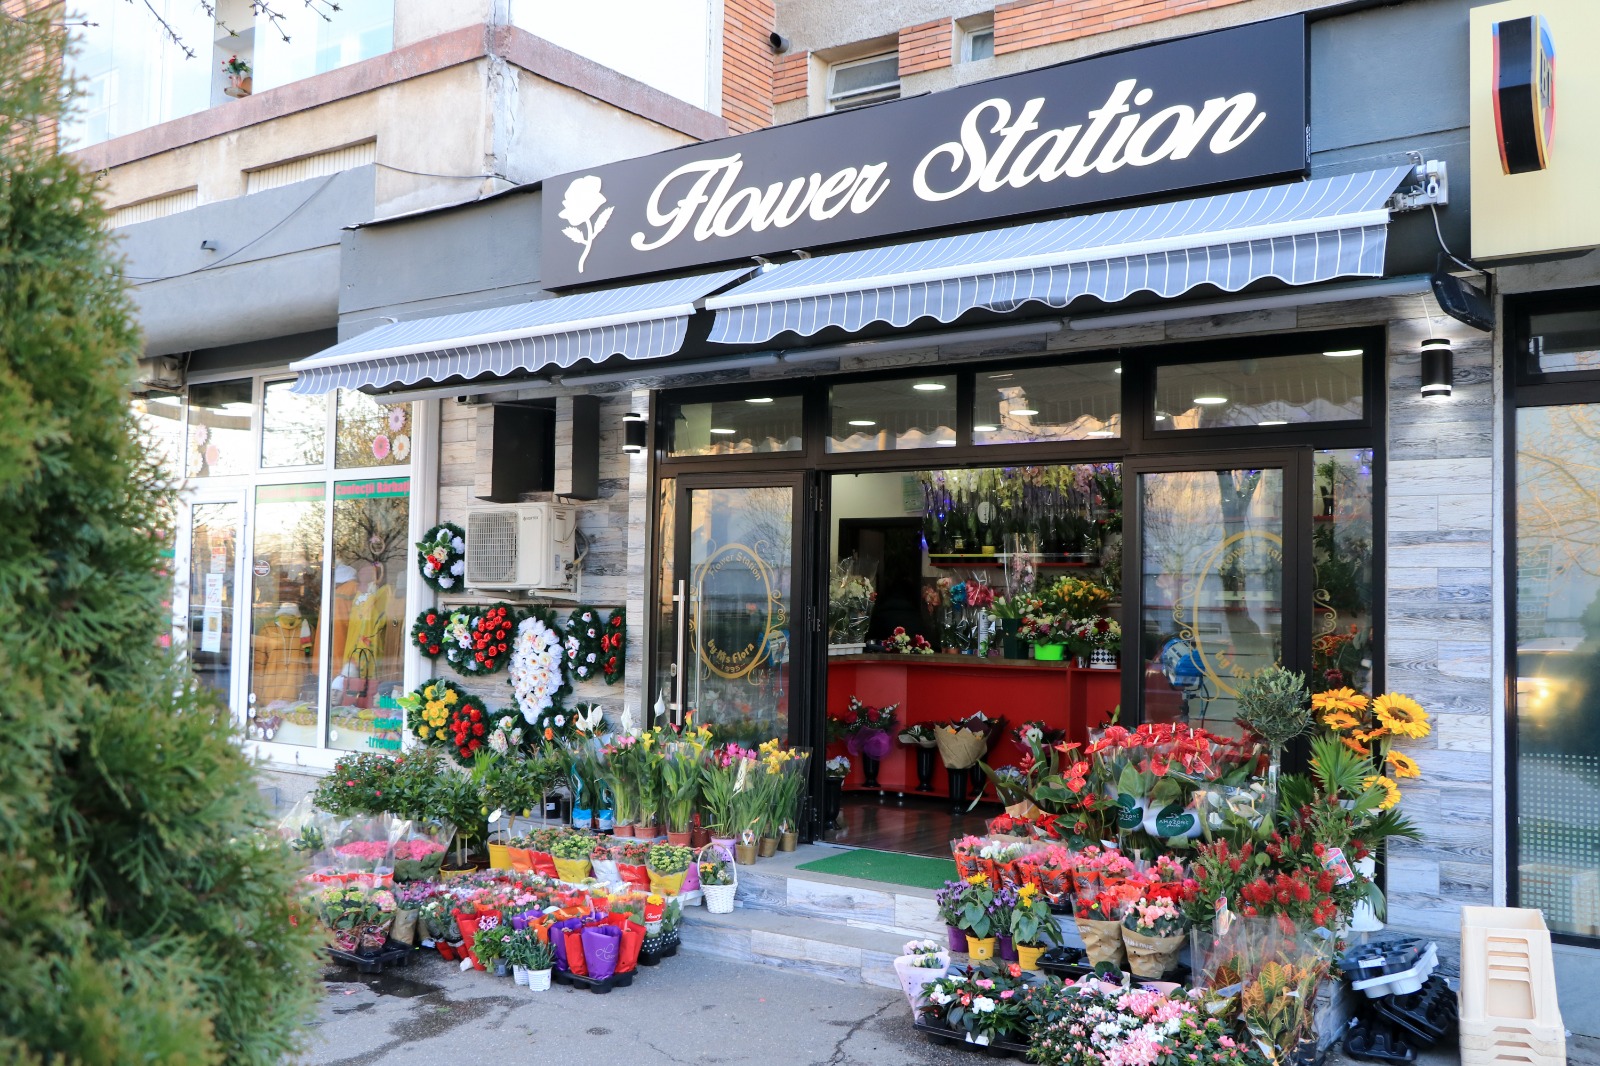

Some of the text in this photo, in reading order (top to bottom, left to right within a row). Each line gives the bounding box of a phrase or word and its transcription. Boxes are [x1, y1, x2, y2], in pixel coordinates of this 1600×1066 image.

[631, 79, 1266, 251] Flower Station
[707, 551, 761, 581] Flower Station
[732, 643, 755, 663] Flora
